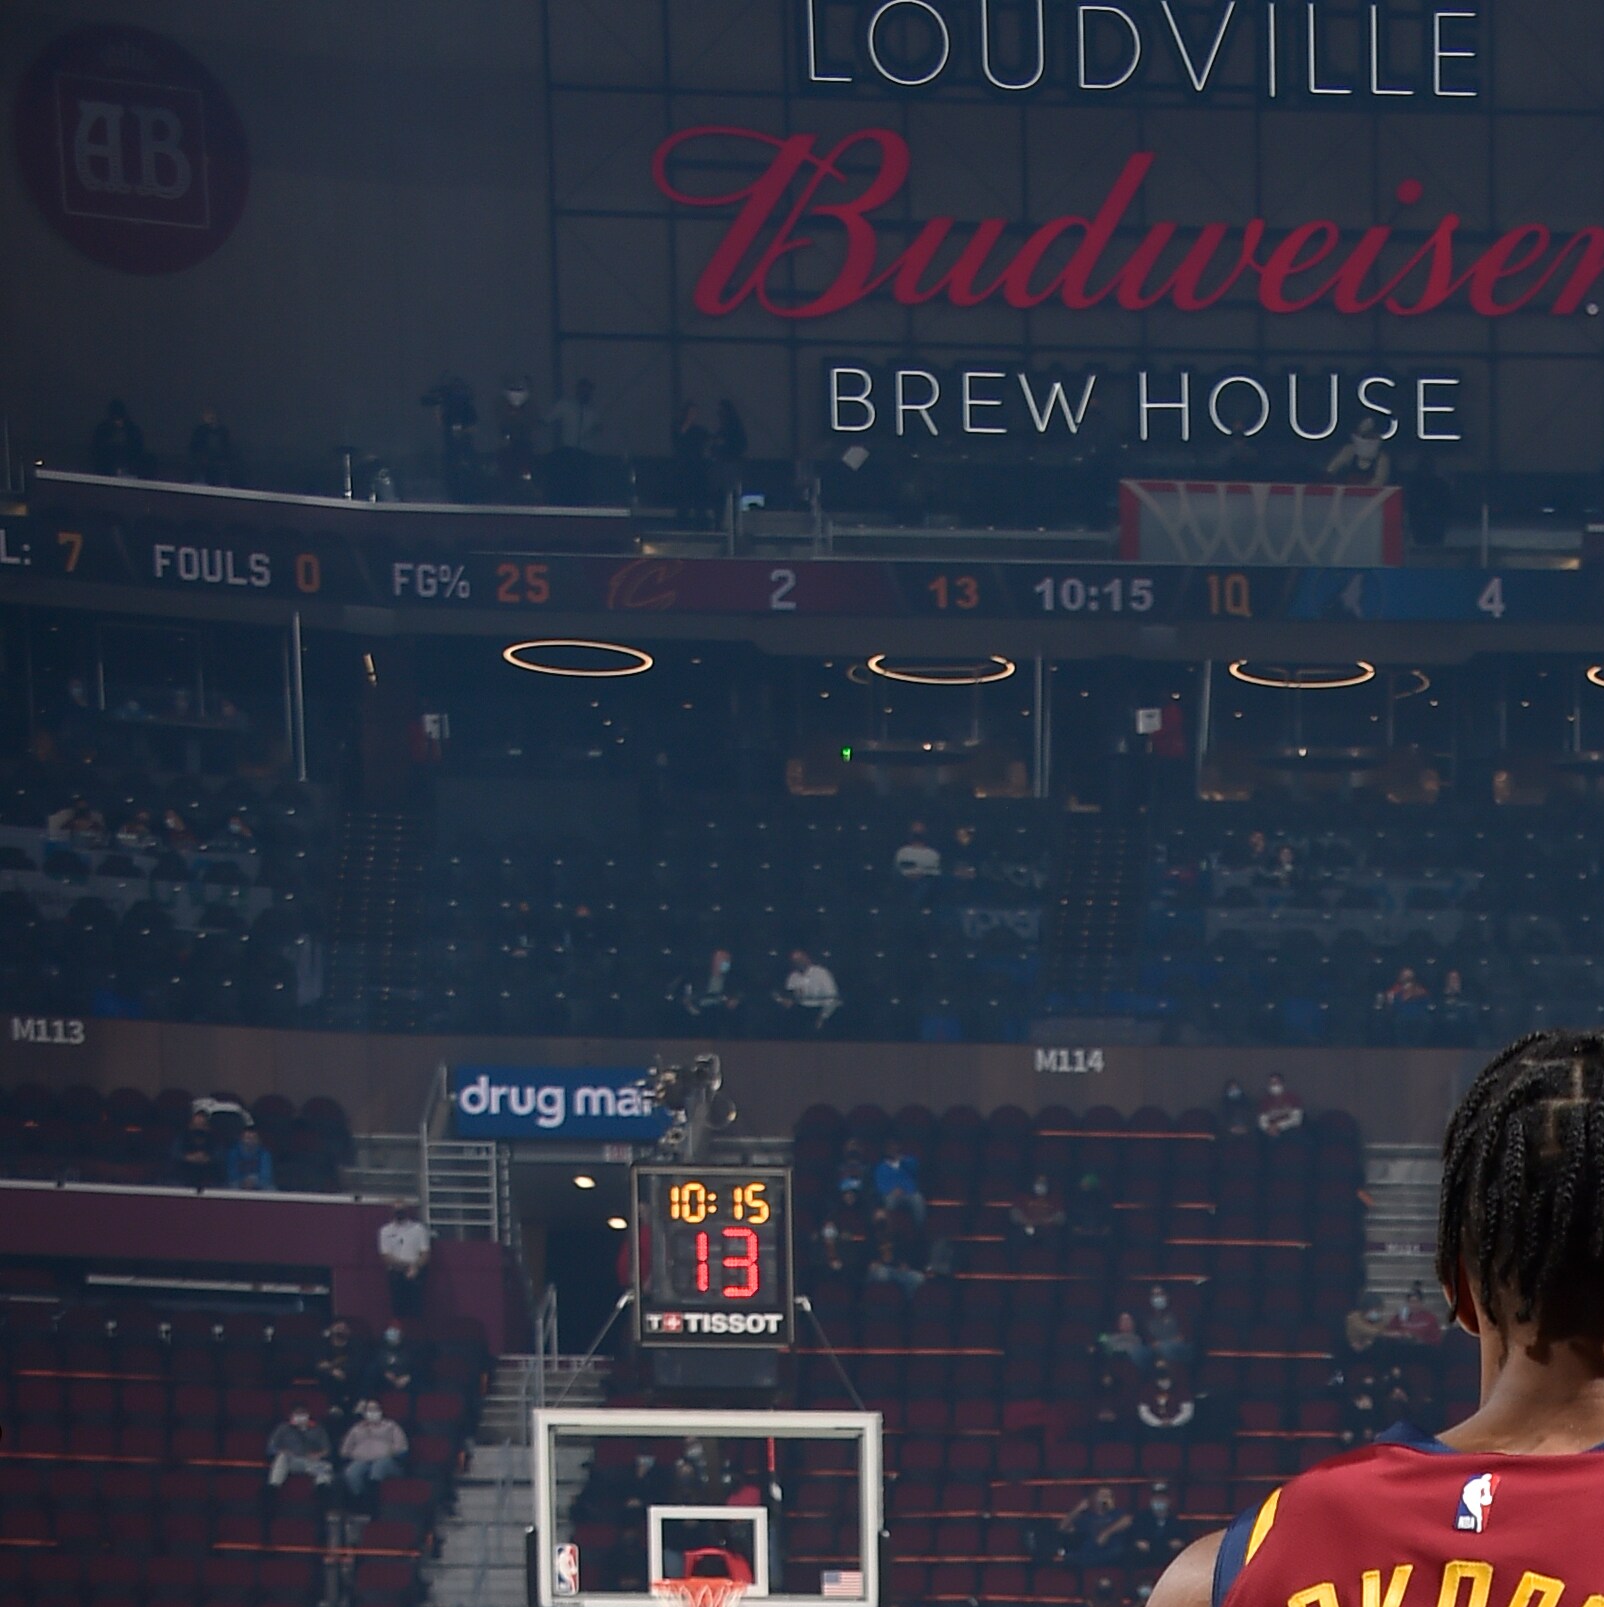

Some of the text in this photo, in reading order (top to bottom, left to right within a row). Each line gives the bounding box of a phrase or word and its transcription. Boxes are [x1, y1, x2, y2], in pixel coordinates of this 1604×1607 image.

[806, 0, 1478, 98] LOUDVILLE
[827, 366, 1462, 442] BREW HOUSE
[57, 530, 83, 573] 7
[152, 543, 320, 593] FOULS 0
[391, 563, 550, 604] FG% 25
[768, 567, 798, 611] 2
[928, 575, 981, 611] 13
[1032, 577, 1155, 613] 10:15
[1477, 578, 1507, 619] 4
[11, 1016, 87, 1046] M113
[1033, 1047, 1106, 1074] M114
[460, 1074, 566, 1129] drug
[669, 1181, 771, 1225] 10:15
[695, 1226, 760, 1299] 13
[684, 1313, 784, 1334] TISSOT
